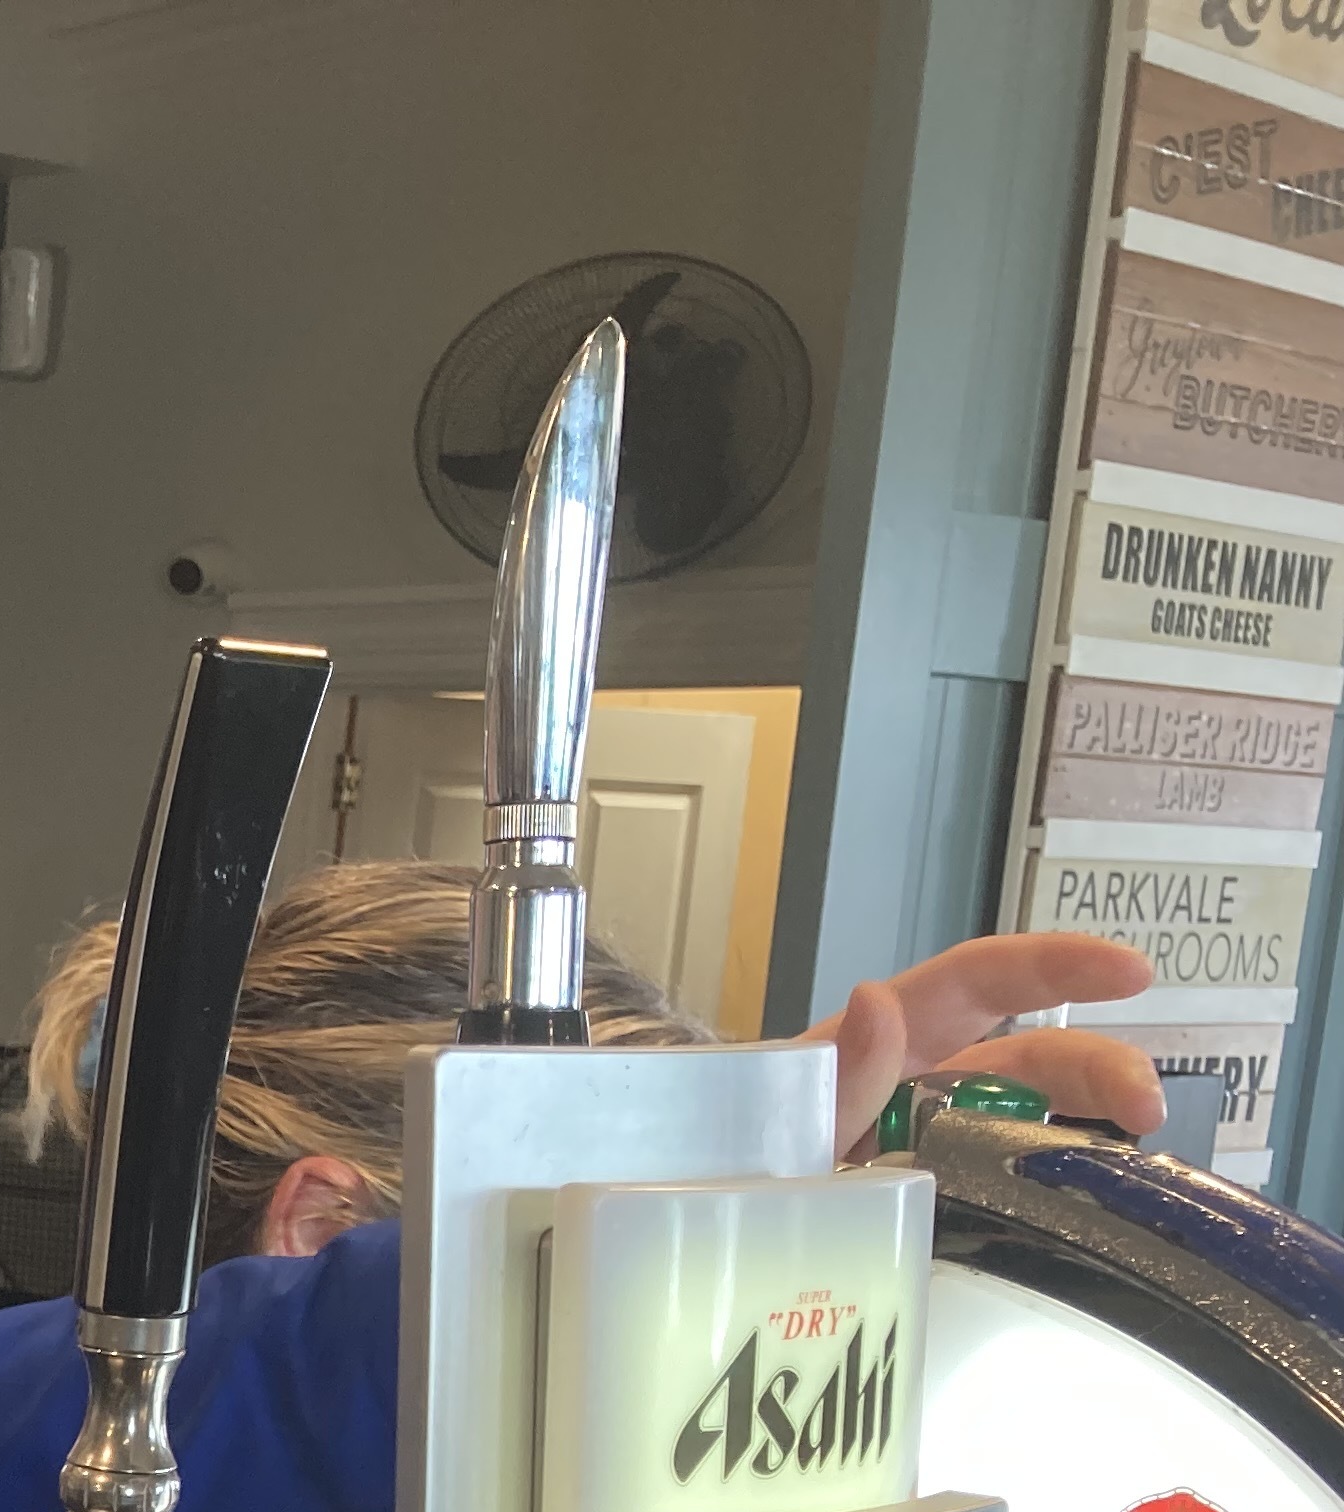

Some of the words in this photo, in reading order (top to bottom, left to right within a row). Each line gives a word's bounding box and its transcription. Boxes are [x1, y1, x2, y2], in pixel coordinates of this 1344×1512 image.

[1101, 520, 1238, 598] DRUNKEN
[1239, 543, 1334, 611] NANNY
[1151, 597, 1208, 641] GOATS
[1209, 604, 1274, 648] CHEESE
[1066, 700, 1224, 761] PALLISER
[1228, 713, 1321, 769] RIDGE
[1154, 769, 1225, 813] LAMB
[1054, 869, 1239, 925] PARKVALE
[795, 1289, 833, 1305] SUPER
[671, 1312, 899, 1487] Asahi
